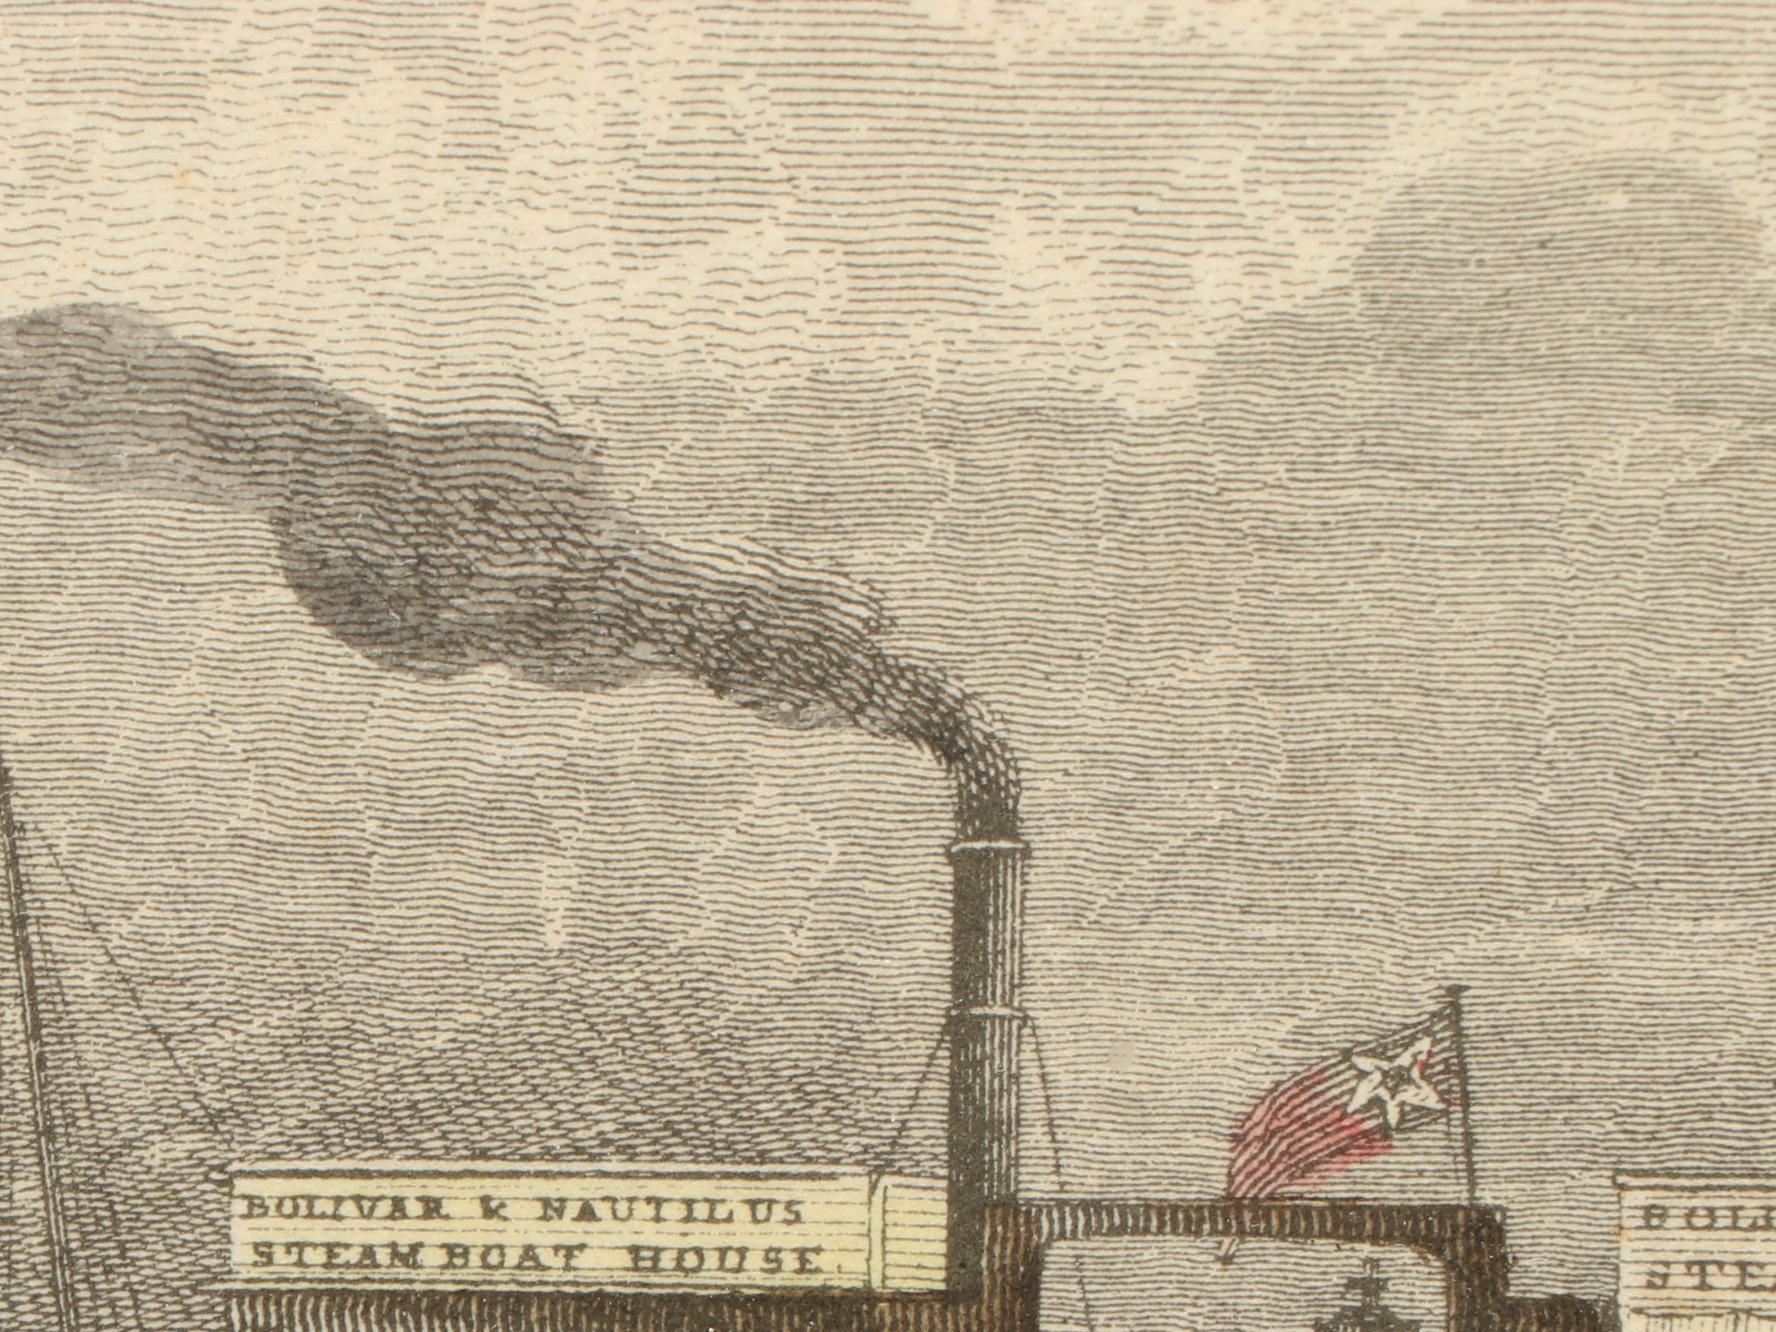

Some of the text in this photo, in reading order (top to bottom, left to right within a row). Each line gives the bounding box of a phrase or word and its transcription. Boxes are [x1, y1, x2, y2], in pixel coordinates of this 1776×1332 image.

[238, 1194, 452, 1222] BOLIVAR
[534, 1196, 804, 1226] NAUTILUS
[251, 1240, 424, 1269] STEAM
[438, 1242, 590, 1271] BOAT
[1645, 1260, 1776, 1291] STE
